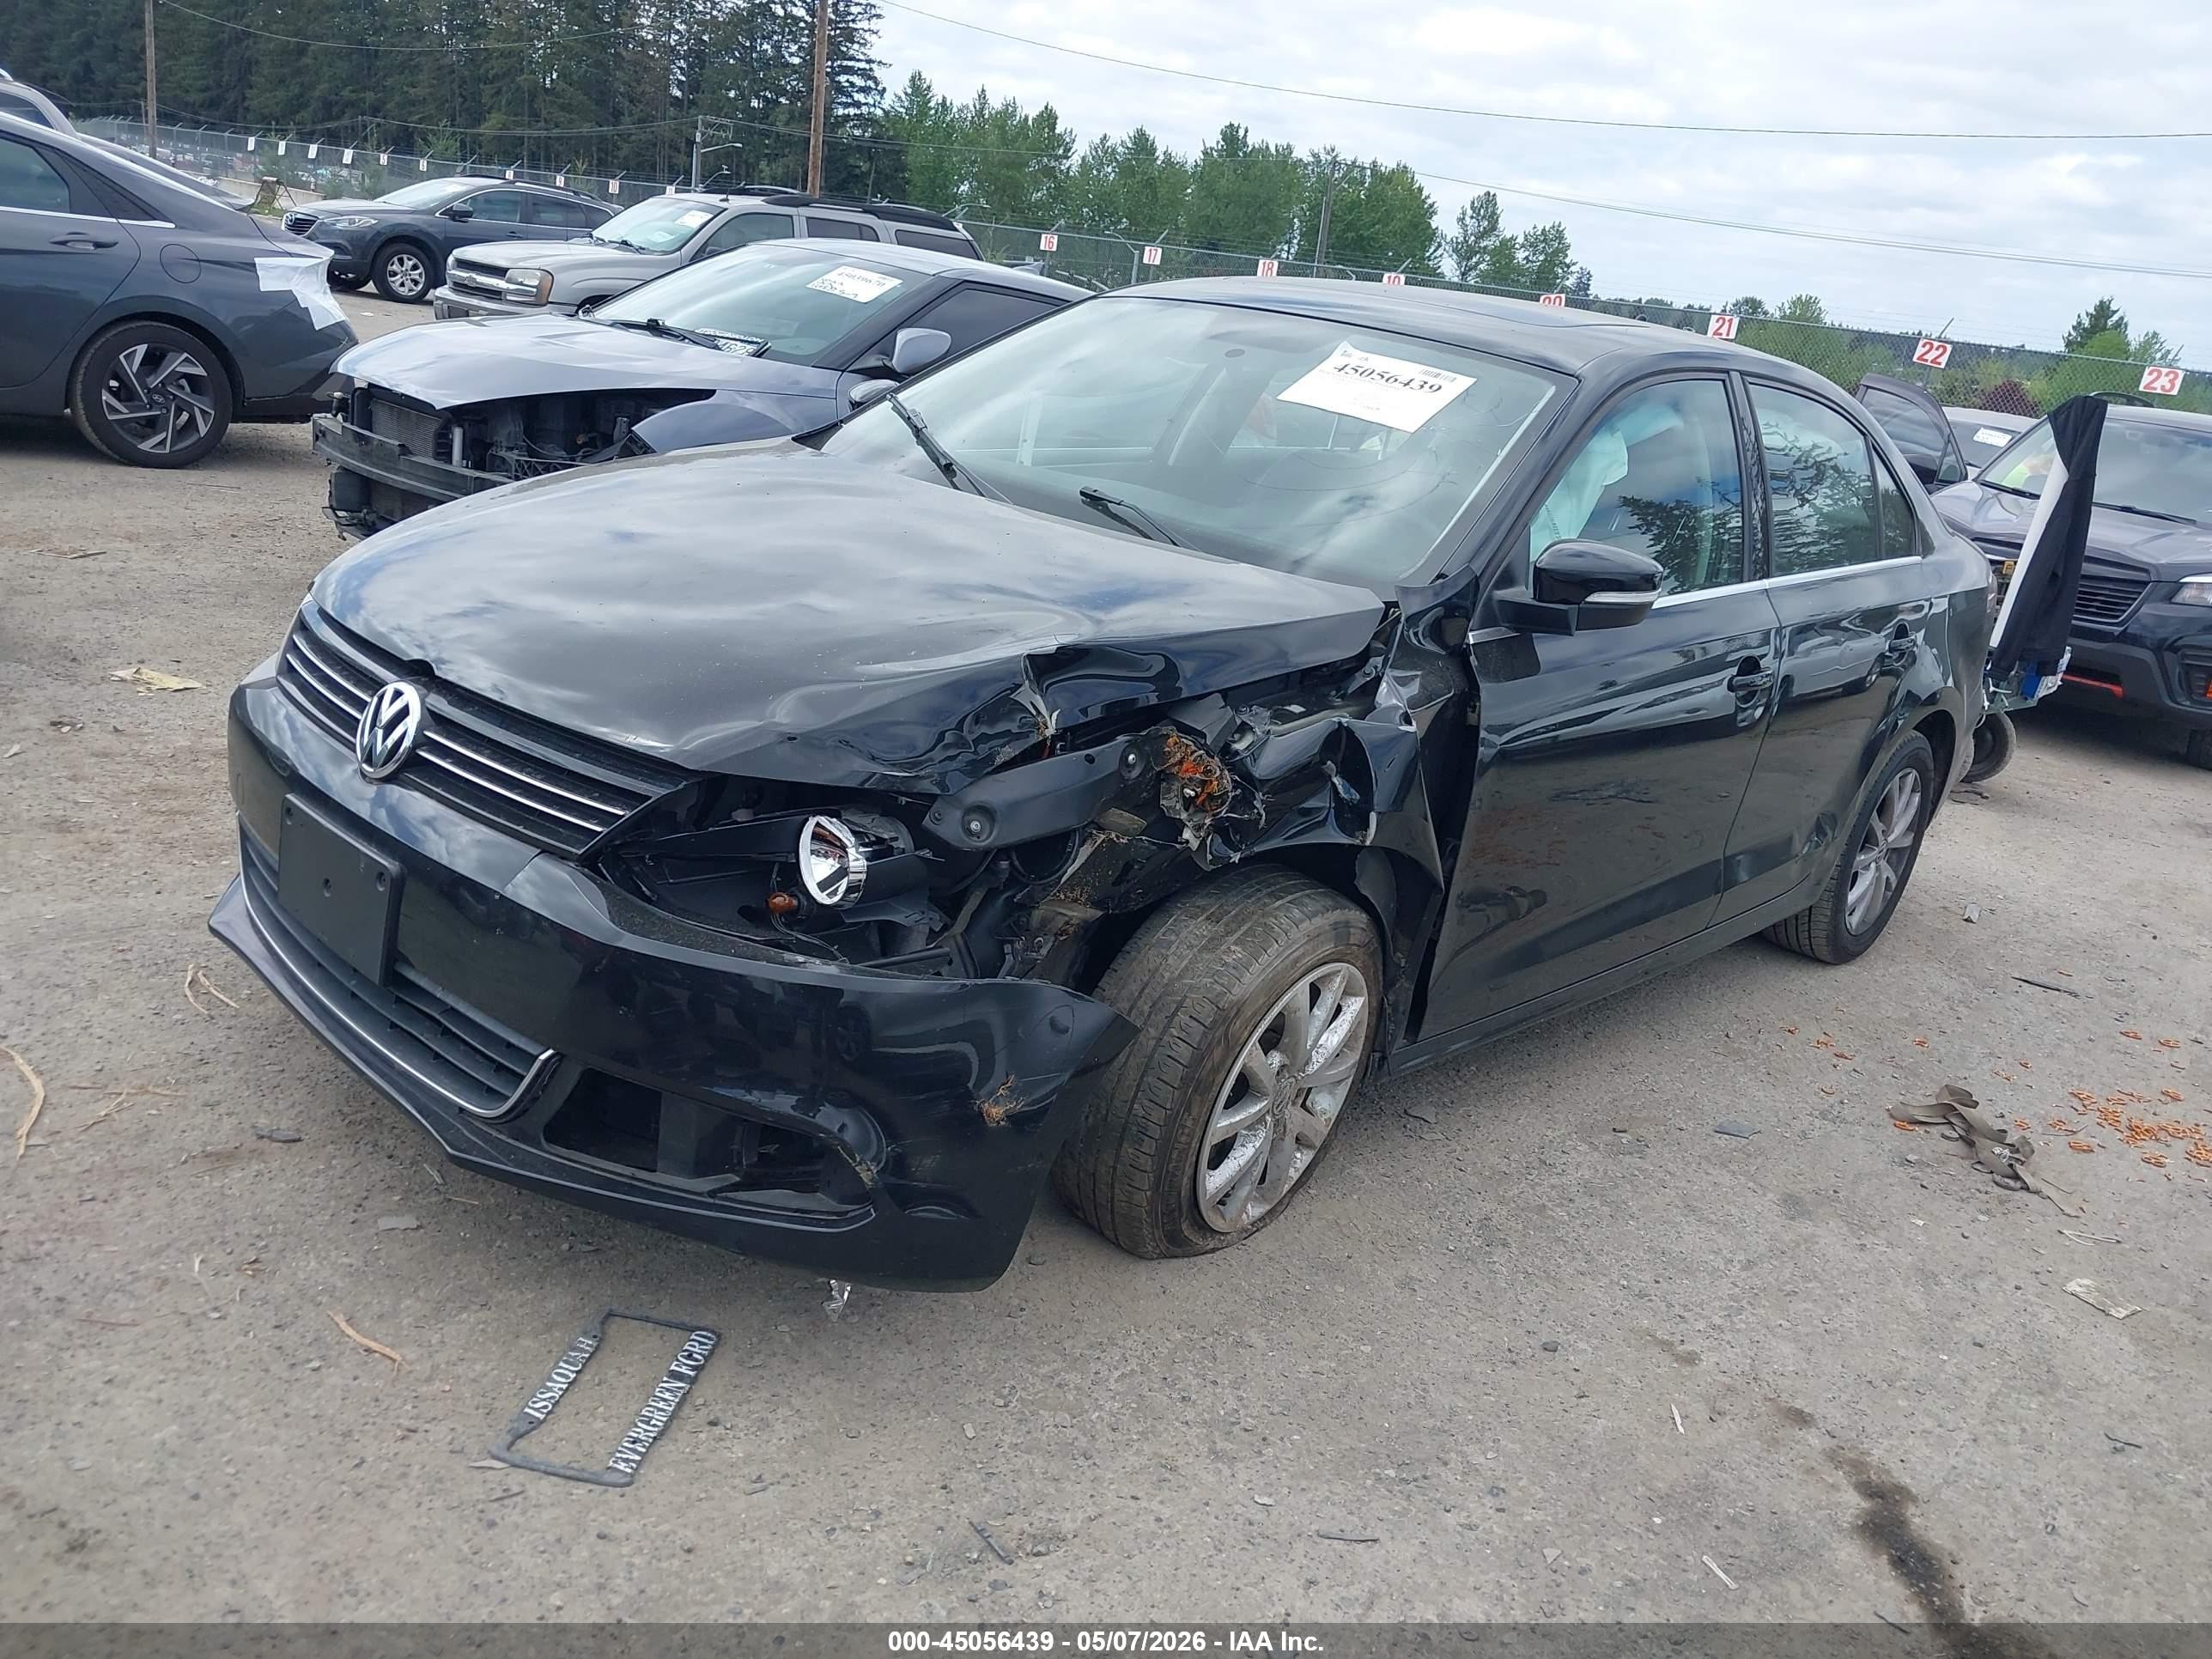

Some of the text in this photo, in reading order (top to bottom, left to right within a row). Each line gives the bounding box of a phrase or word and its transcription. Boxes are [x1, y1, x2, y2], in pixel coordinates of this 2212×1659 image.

[1043, 235, 1055, 250] 16
[1147, 248, 1158, 264] 17
[1262, 260, 1274, 276] 18
[1713, 316, 1734, 337] 21
[1916, 341, 1948, 366] 22
[1333, 363, 1443, 393] 45056439
[2142, 368, 2179, 393] 23
[523, 1337, 599, 1420] ISSAQUAH
[606, 1330, 718, 1474] EVERGREEN FORD
